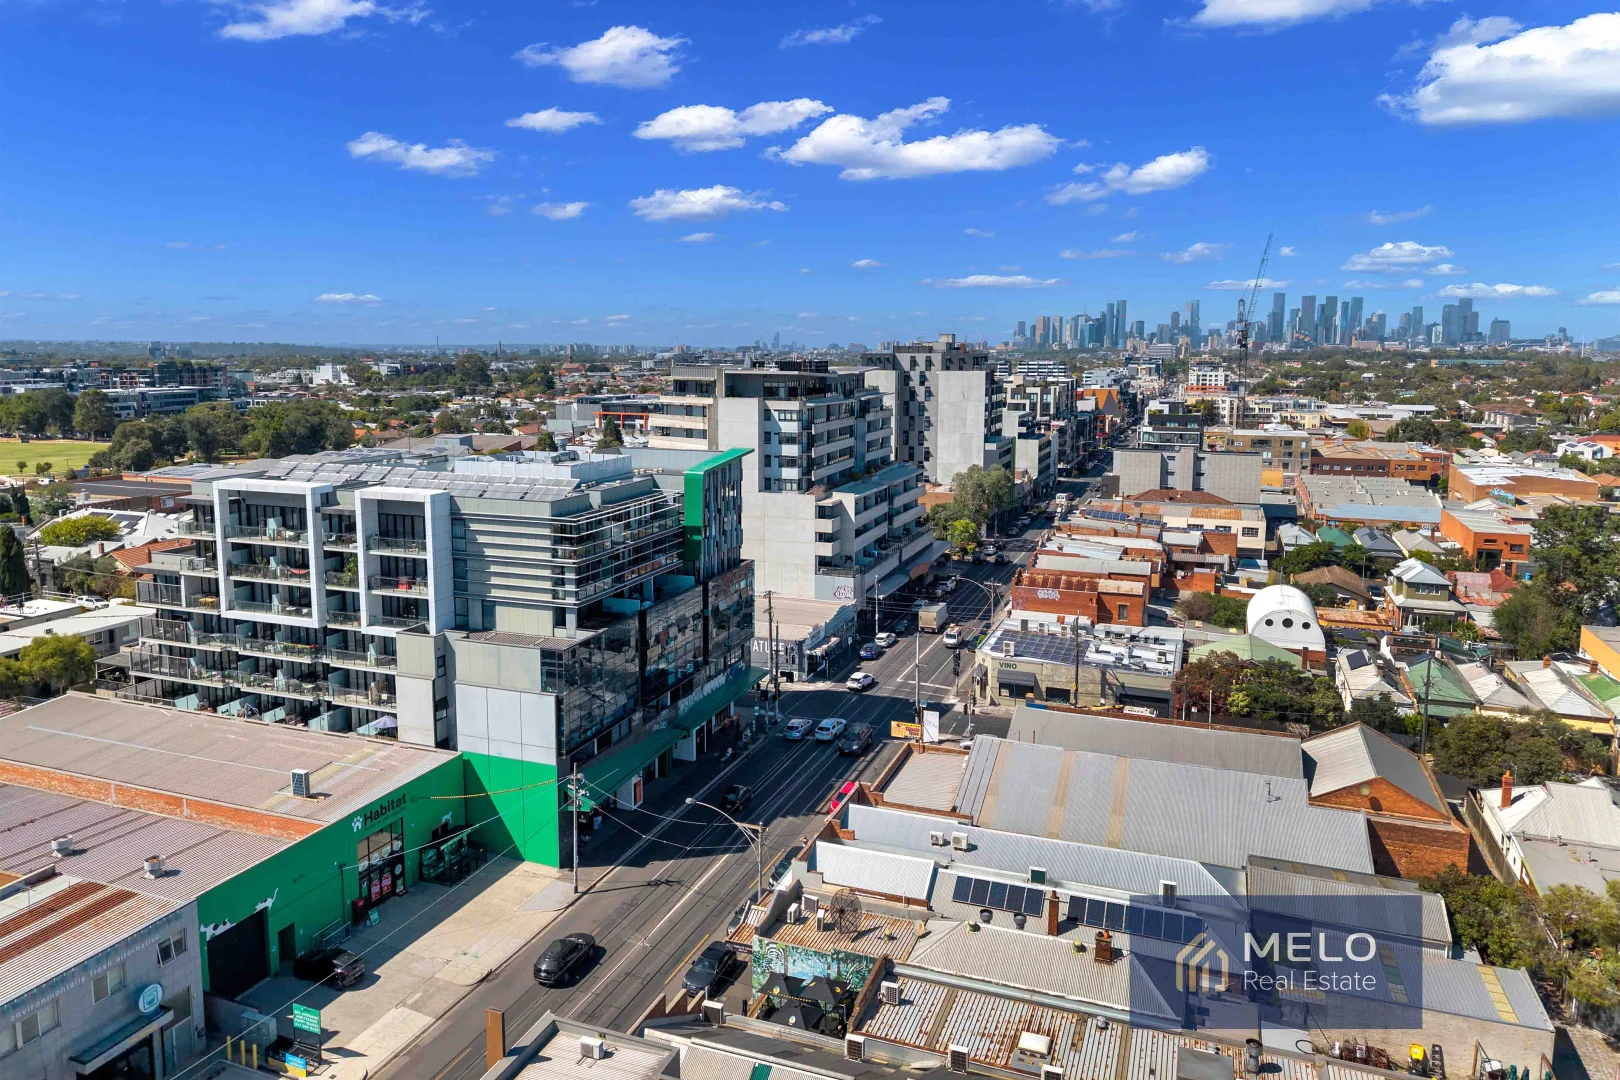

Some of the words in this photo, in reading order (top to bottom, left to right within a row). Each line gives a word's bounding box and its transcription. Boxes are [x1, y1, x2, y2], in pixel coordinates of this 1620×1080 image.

[998, 661, 1018, 670] VINO
[364, 793, 407, 825] Habitat
[10, 974, 87, 1022] environmentally
[89, 960, 113, 978] fresh
[115, 934, 161, 963] alternative
